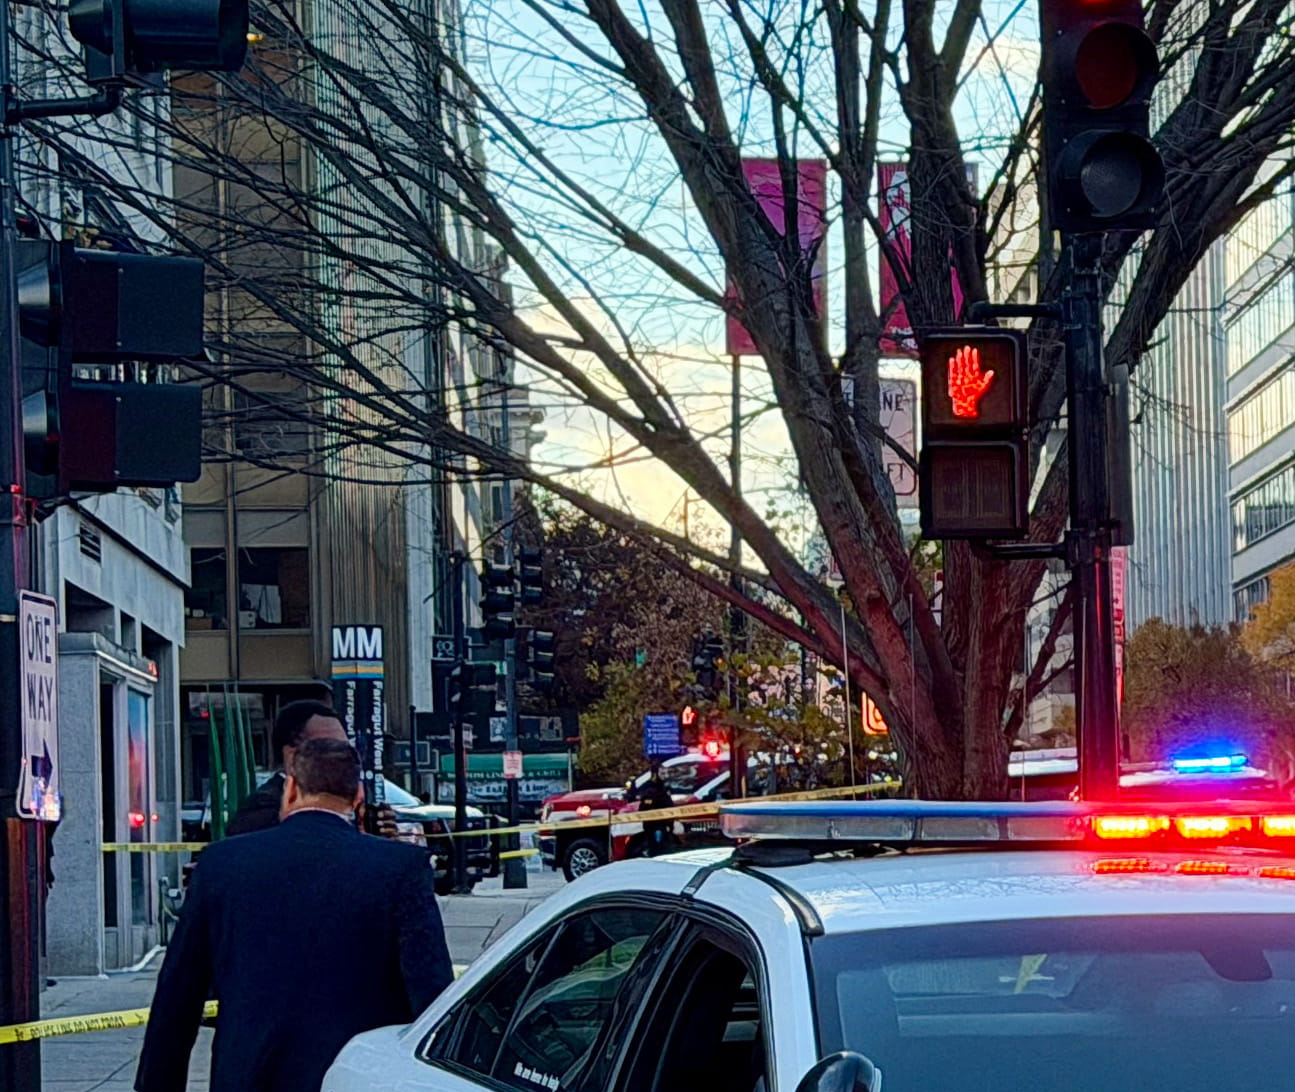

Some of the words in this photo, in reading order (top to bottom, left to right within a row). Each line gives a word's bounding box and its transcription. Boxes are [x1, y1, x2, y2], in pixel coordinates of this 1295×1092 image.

[26, 612, 51, 665] ONE
[27, 672, 53, 722] WAY
[345, 680, 356, 736] Farragut
[371, 680, 384, 736] Farragut
[373, 737, 384, 771] West
